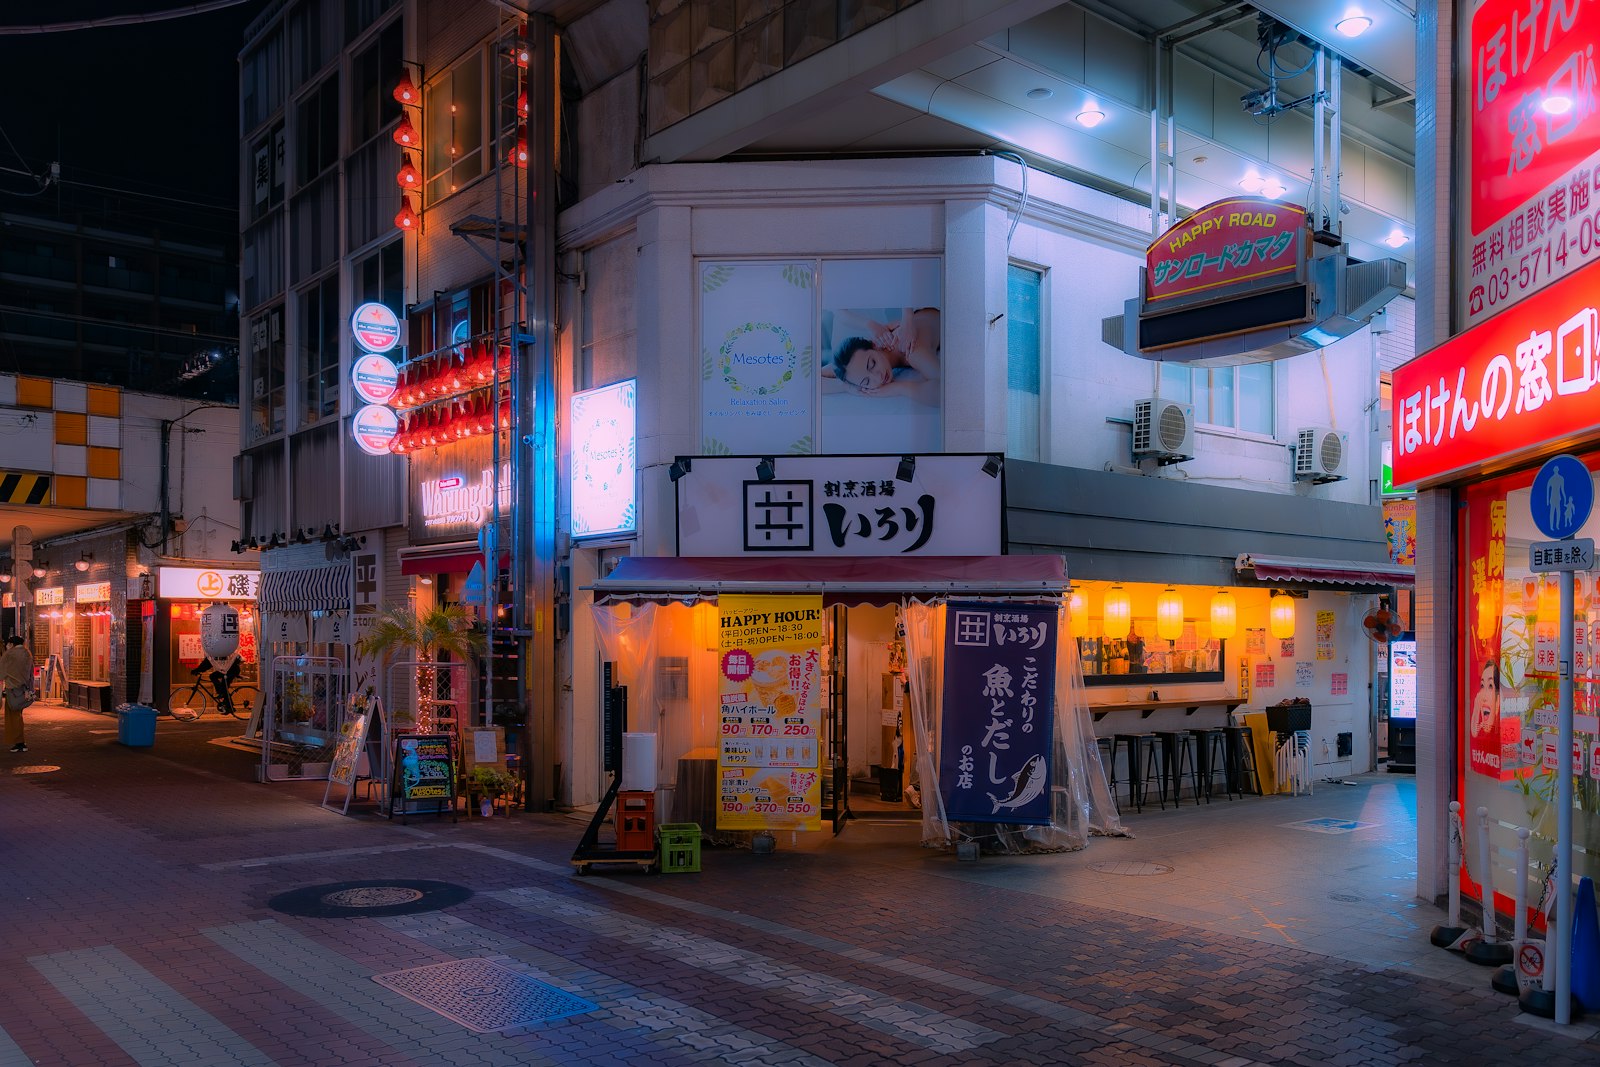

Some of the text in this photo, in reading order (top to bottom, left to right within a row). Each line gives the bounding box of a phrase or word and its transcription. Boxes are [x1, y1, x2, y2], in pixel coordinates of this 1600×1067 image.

[1169, 213, 1277, 253] HAPPY ROAD
[1154, 231, 1294, 286] サンロードカマタ
[733, 353, 784, 365] Mesotes
[1399, 308, 1597, 456] ほけんの窓口
[730, 398, 788, 406] Relaxation Salon
[824, 480, 895, 497] 割烹酒場
[421, 480, 482, 523] Warung
[822, 494, 935, 553] いろり
[1533, 546, 1587, 565] 自転車を除く
[721, 609, 820, 628] HAPPY HOUR!
[993, 622, 1048, 650] いろり
[1538, 650, 1555, 666] 保険
[1021, 656, 1039, 734] こだわりの
[721, 704, 776, 715] 角ハイボール
[722, 724, 816, 735] 90円 170円 250円
[981, 663, 1014, 785] 魚とだし
[957, 745, 974, 789] のお店
[722, 803, 816, 813] 190円 370円 550円
